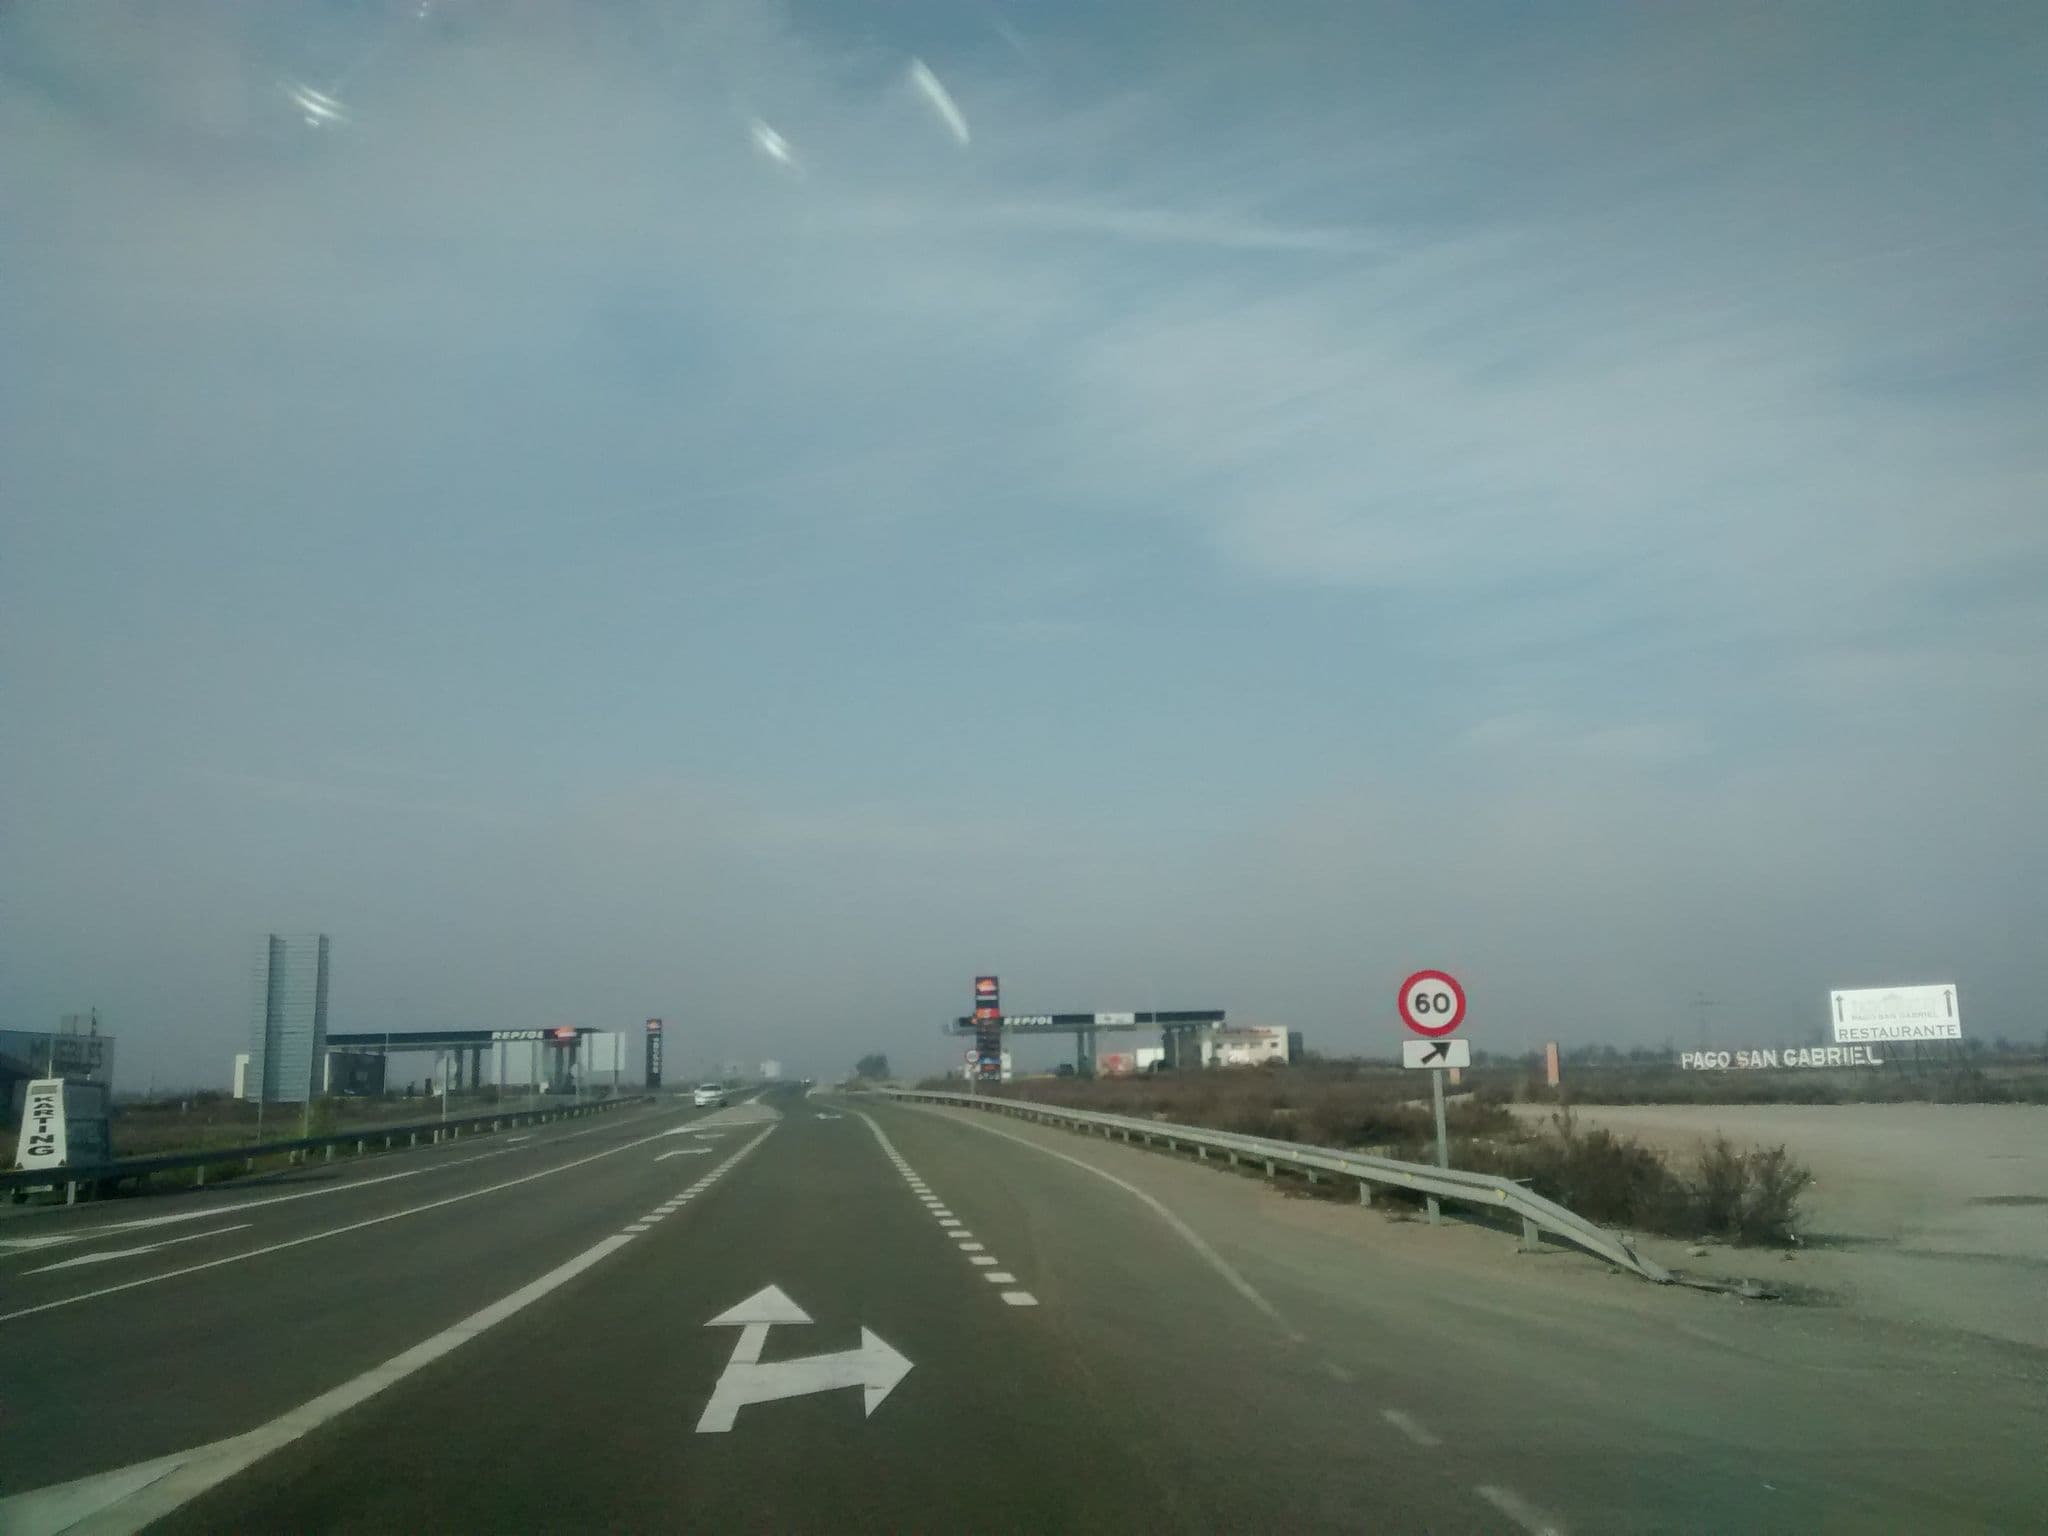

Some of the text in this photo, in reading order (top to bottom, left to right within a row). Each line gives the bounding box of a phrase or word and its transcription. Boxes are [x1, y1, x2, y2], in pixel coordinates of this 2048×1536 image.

[1415, 993, 1450, 1014] 60
[493, 1031, 544, 1040] REPSOL
[1839, 1025, 1957, 1040] RESTAURANTE
[1681, 1045, 1884, 1070] PAGO SAN GABRIEL
[27, 1096, 55, 1156] KARTING
